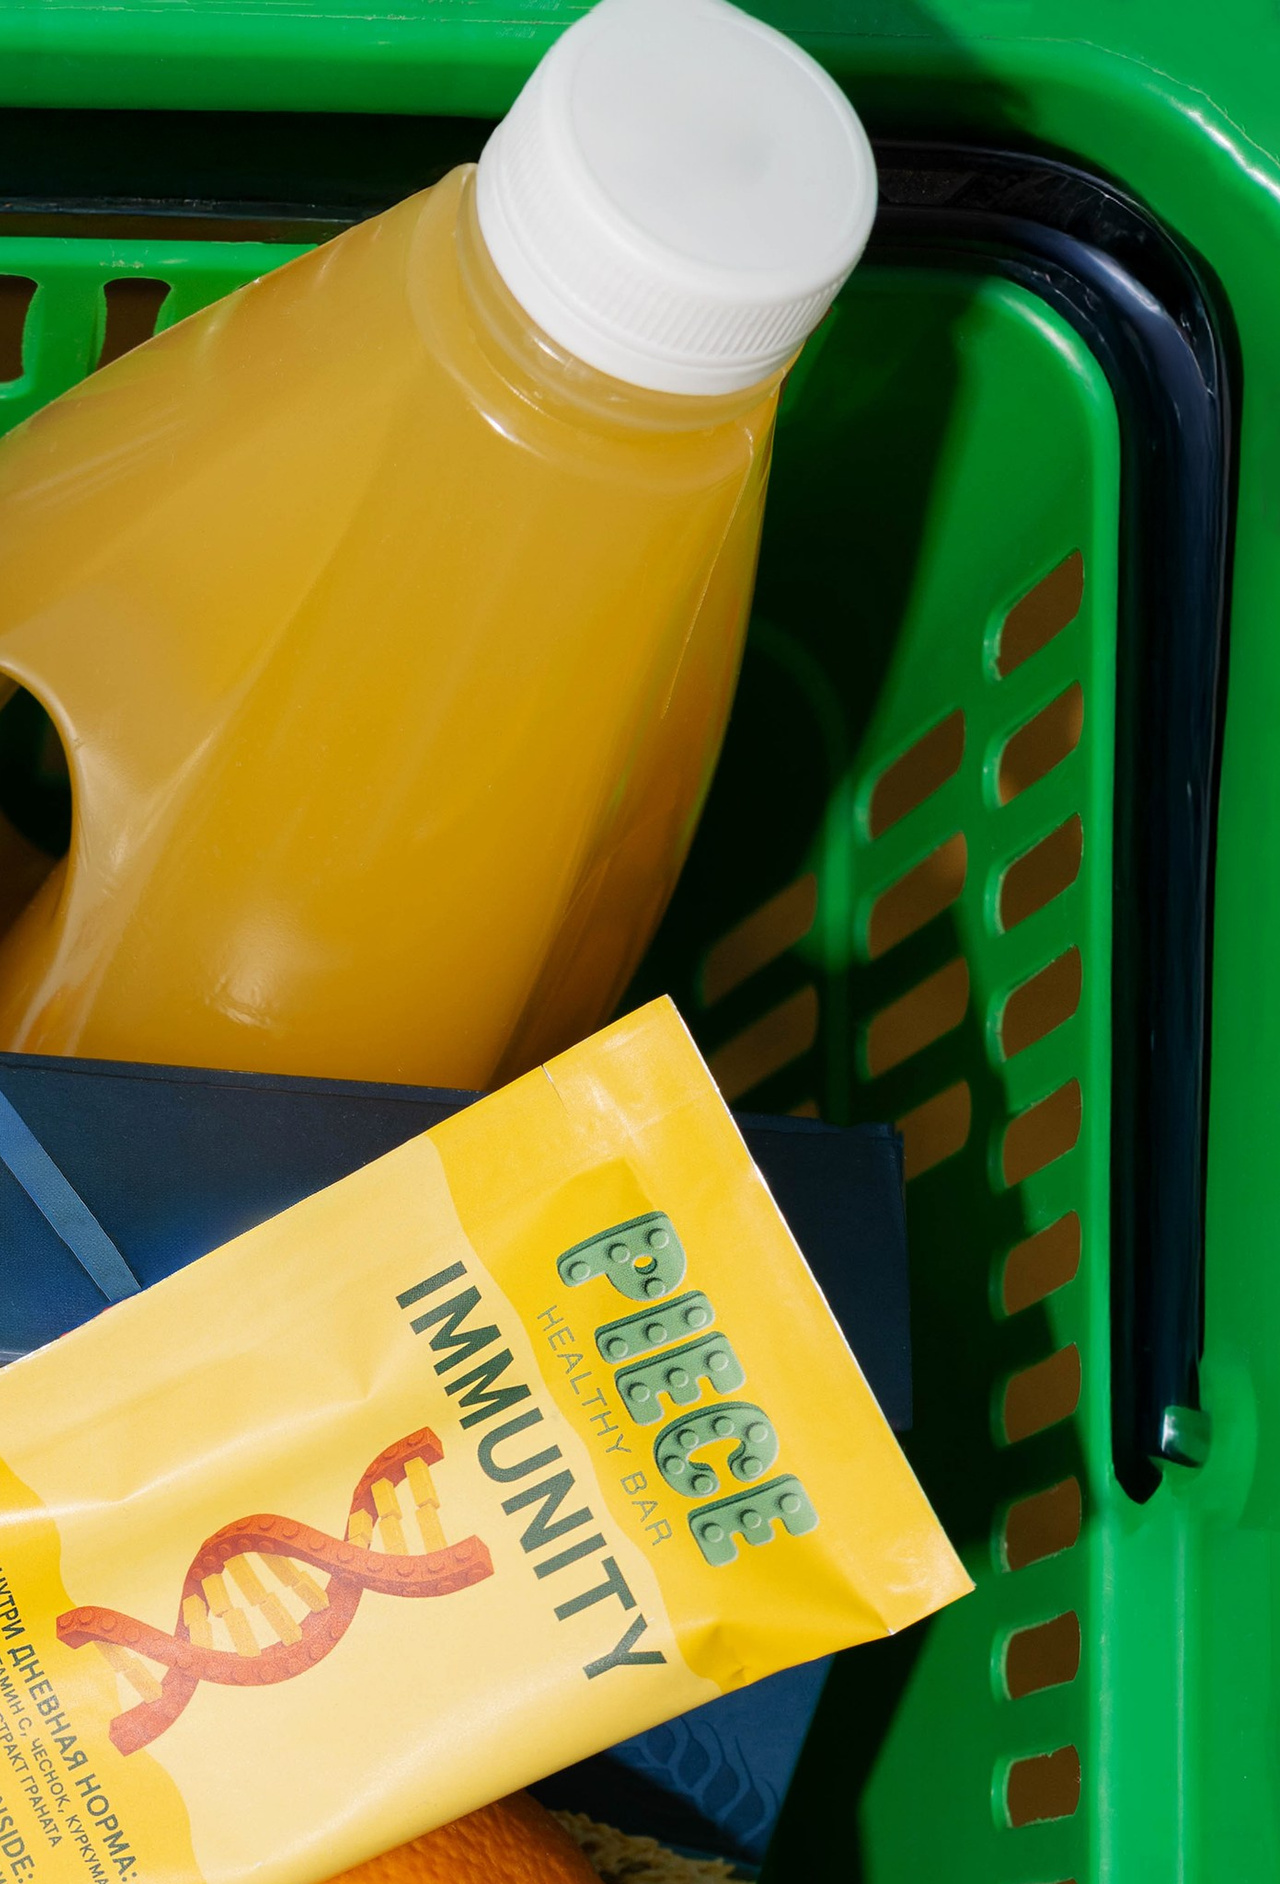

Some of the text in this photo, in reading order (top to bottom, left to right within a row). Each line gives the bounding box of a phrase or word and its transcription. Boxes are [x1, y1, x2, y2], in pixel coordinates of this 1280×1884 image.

[395, 1260, 668, 1680] IMMUNITY
[536, 1304, 673, 1546] HEALTHY BAR
[556, 1210, 820, 1567] PIECE
[6, 1644, 88, 1771] ДНЕВНАЯ
[75, 1773, 137, 1882] НОРМА:
[20, 1775, 63, 1847] ГРАНАТА
[31, 1737, 71, 1813] ЧЕСНОК,
